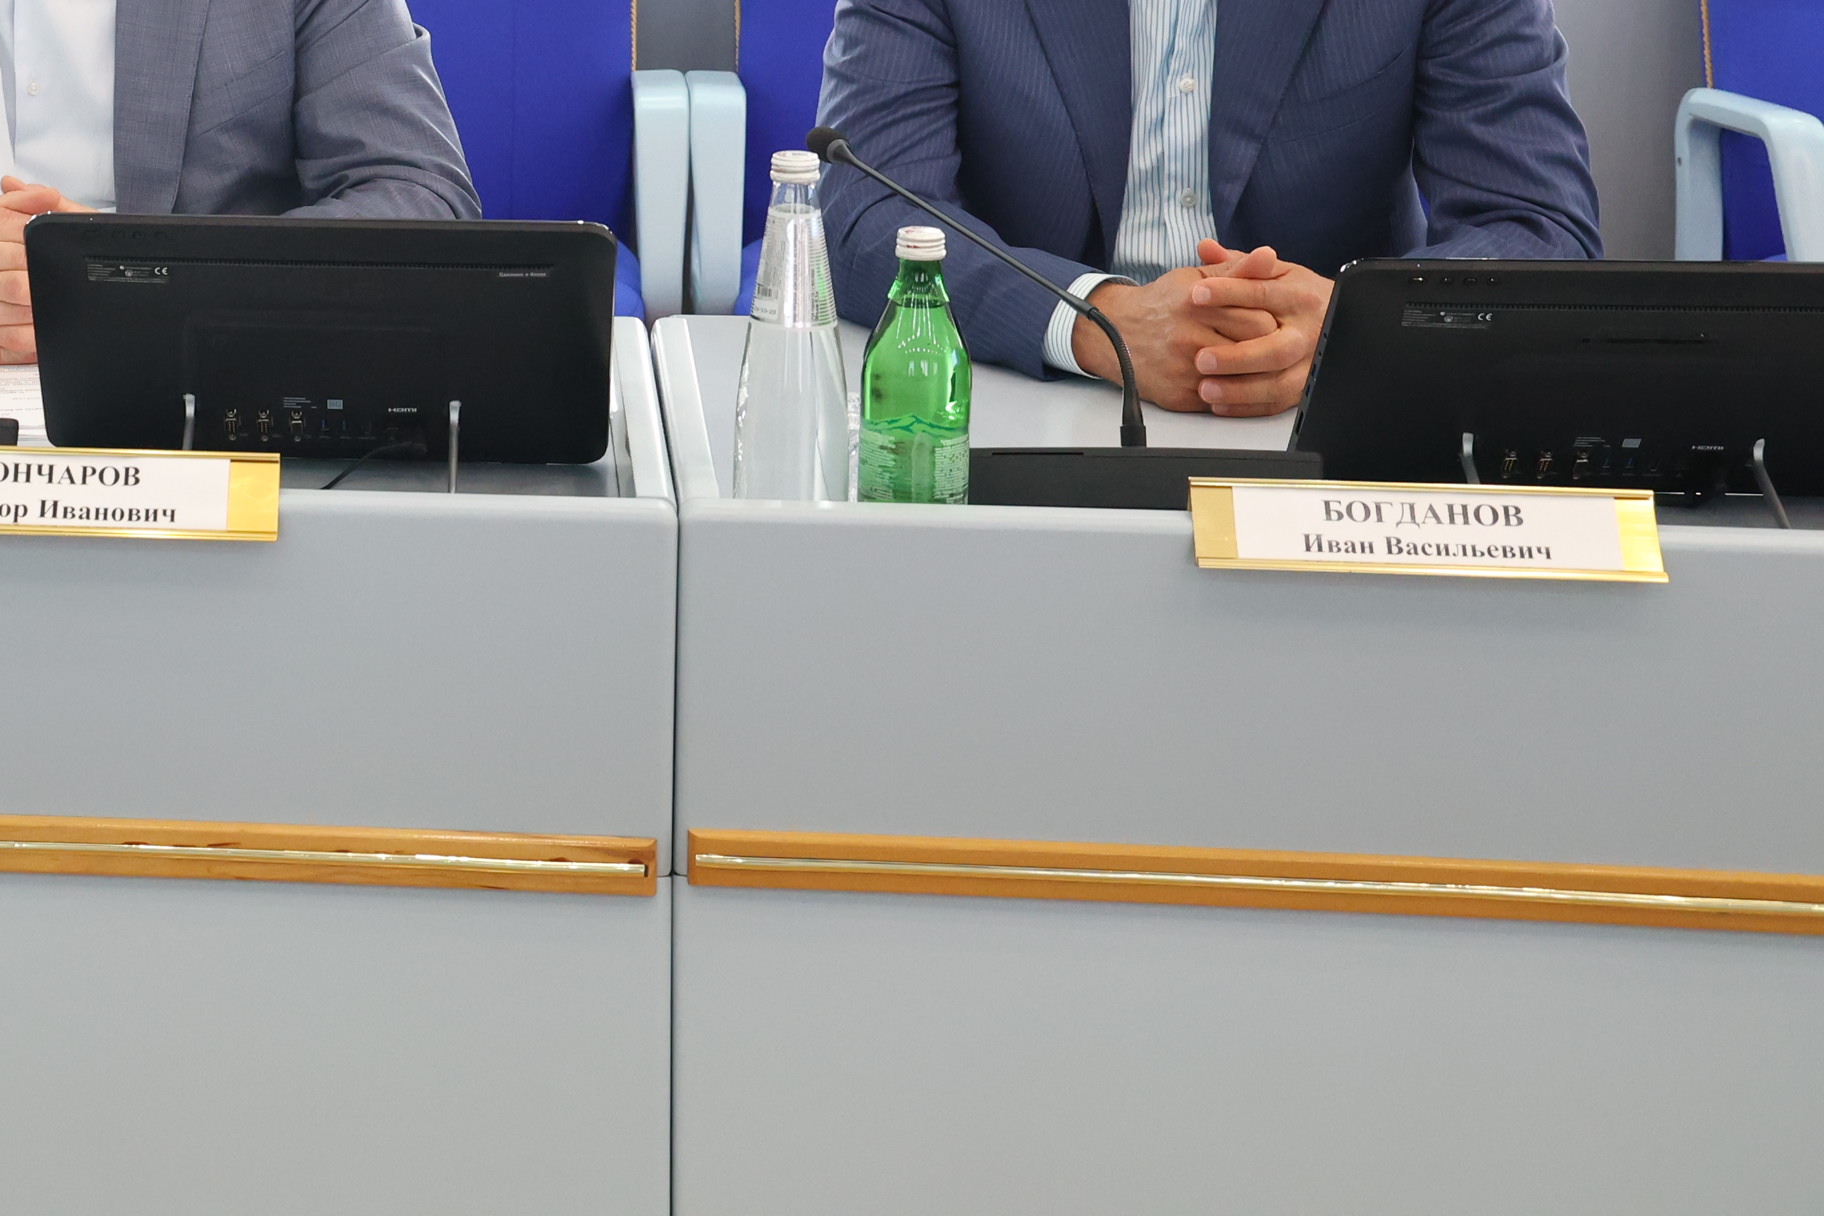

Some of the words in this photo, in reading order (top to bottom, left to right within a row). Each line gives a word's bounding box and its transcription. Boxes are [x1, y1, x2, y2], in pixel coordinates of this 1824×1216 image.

[38, 499, 177, 523] Иванович
[1321, 499, 1525, 529] БОГДАНОВ
[1302, 533, 1375, 556] Иван
[1385, 536, 1553, 561] Васильевич
